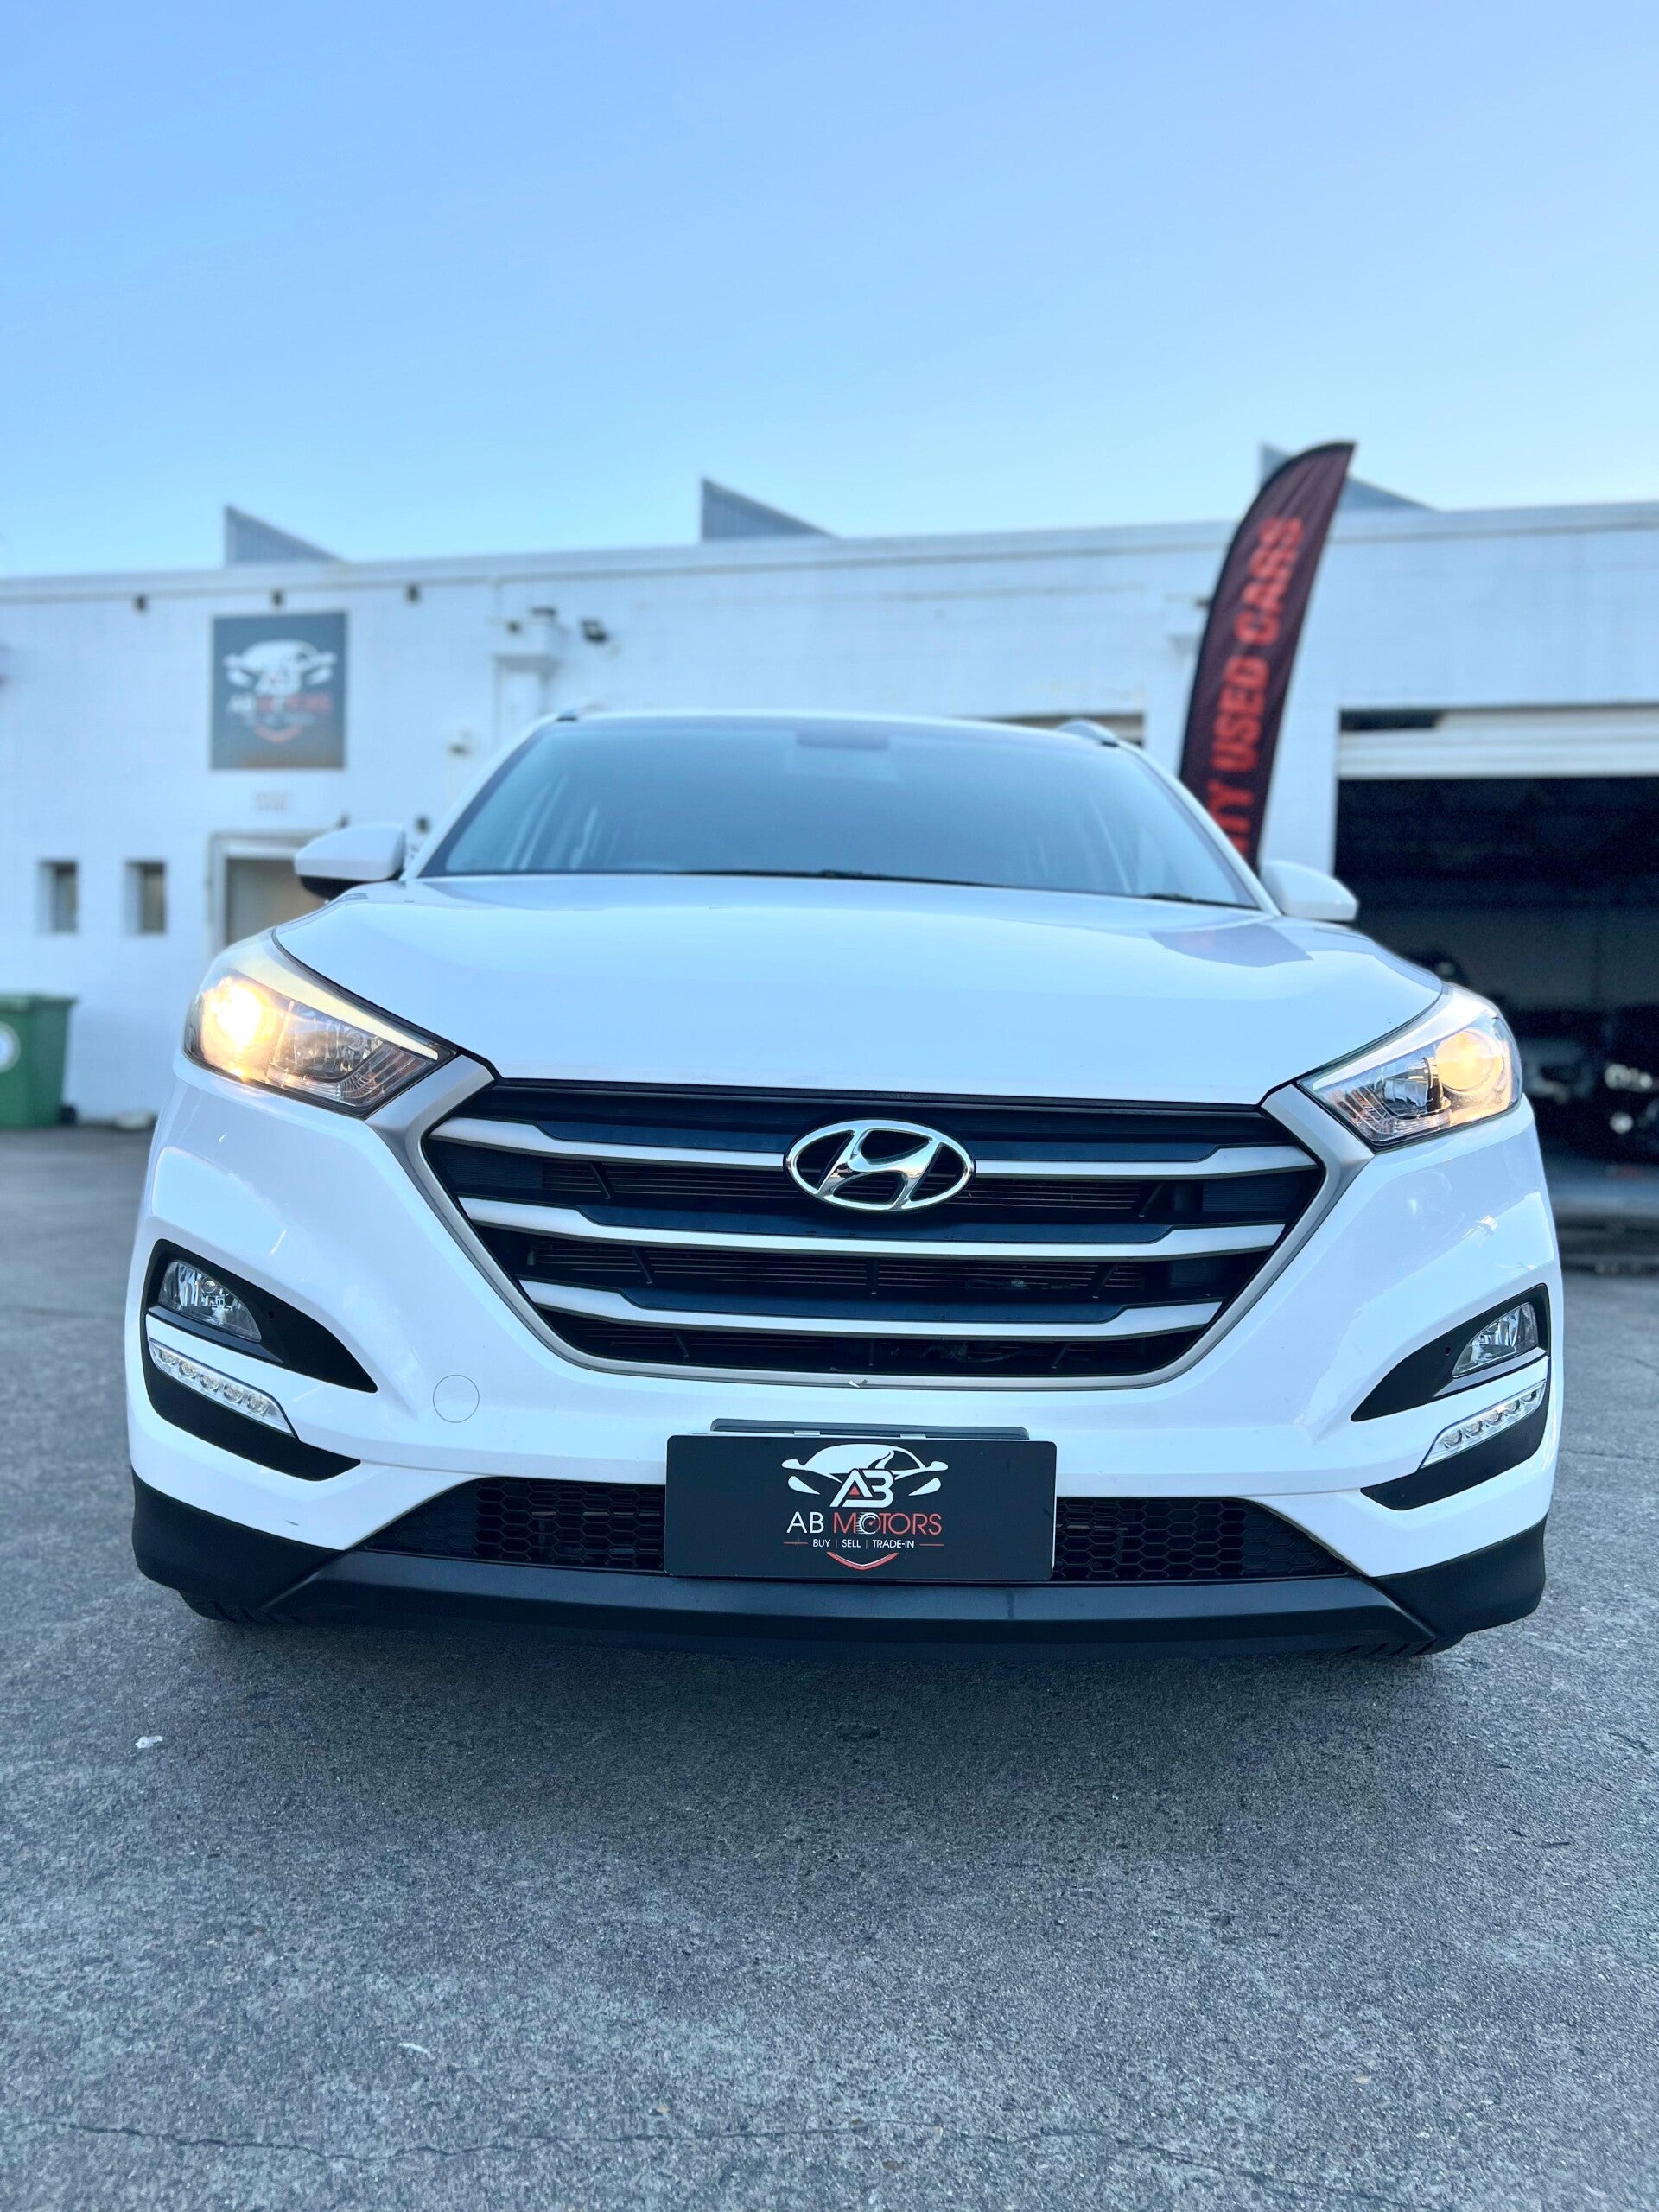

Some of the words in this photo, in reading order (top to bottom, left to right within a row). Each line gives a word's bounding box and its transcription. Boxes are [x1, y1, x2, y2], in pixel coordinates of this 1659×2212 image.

[1234, 517, 1305, 645] CARS
[1212, 657, 1270, 772] USED
[786, 1511, 824, 1534] AB
[833, 1512, 943, 1535] MOTORS
[812, 1539, 831, 1548] BUY
[842, 1539, 861, 1548] SELL
[873, 1540, 915, 1548] TRADE-IN
